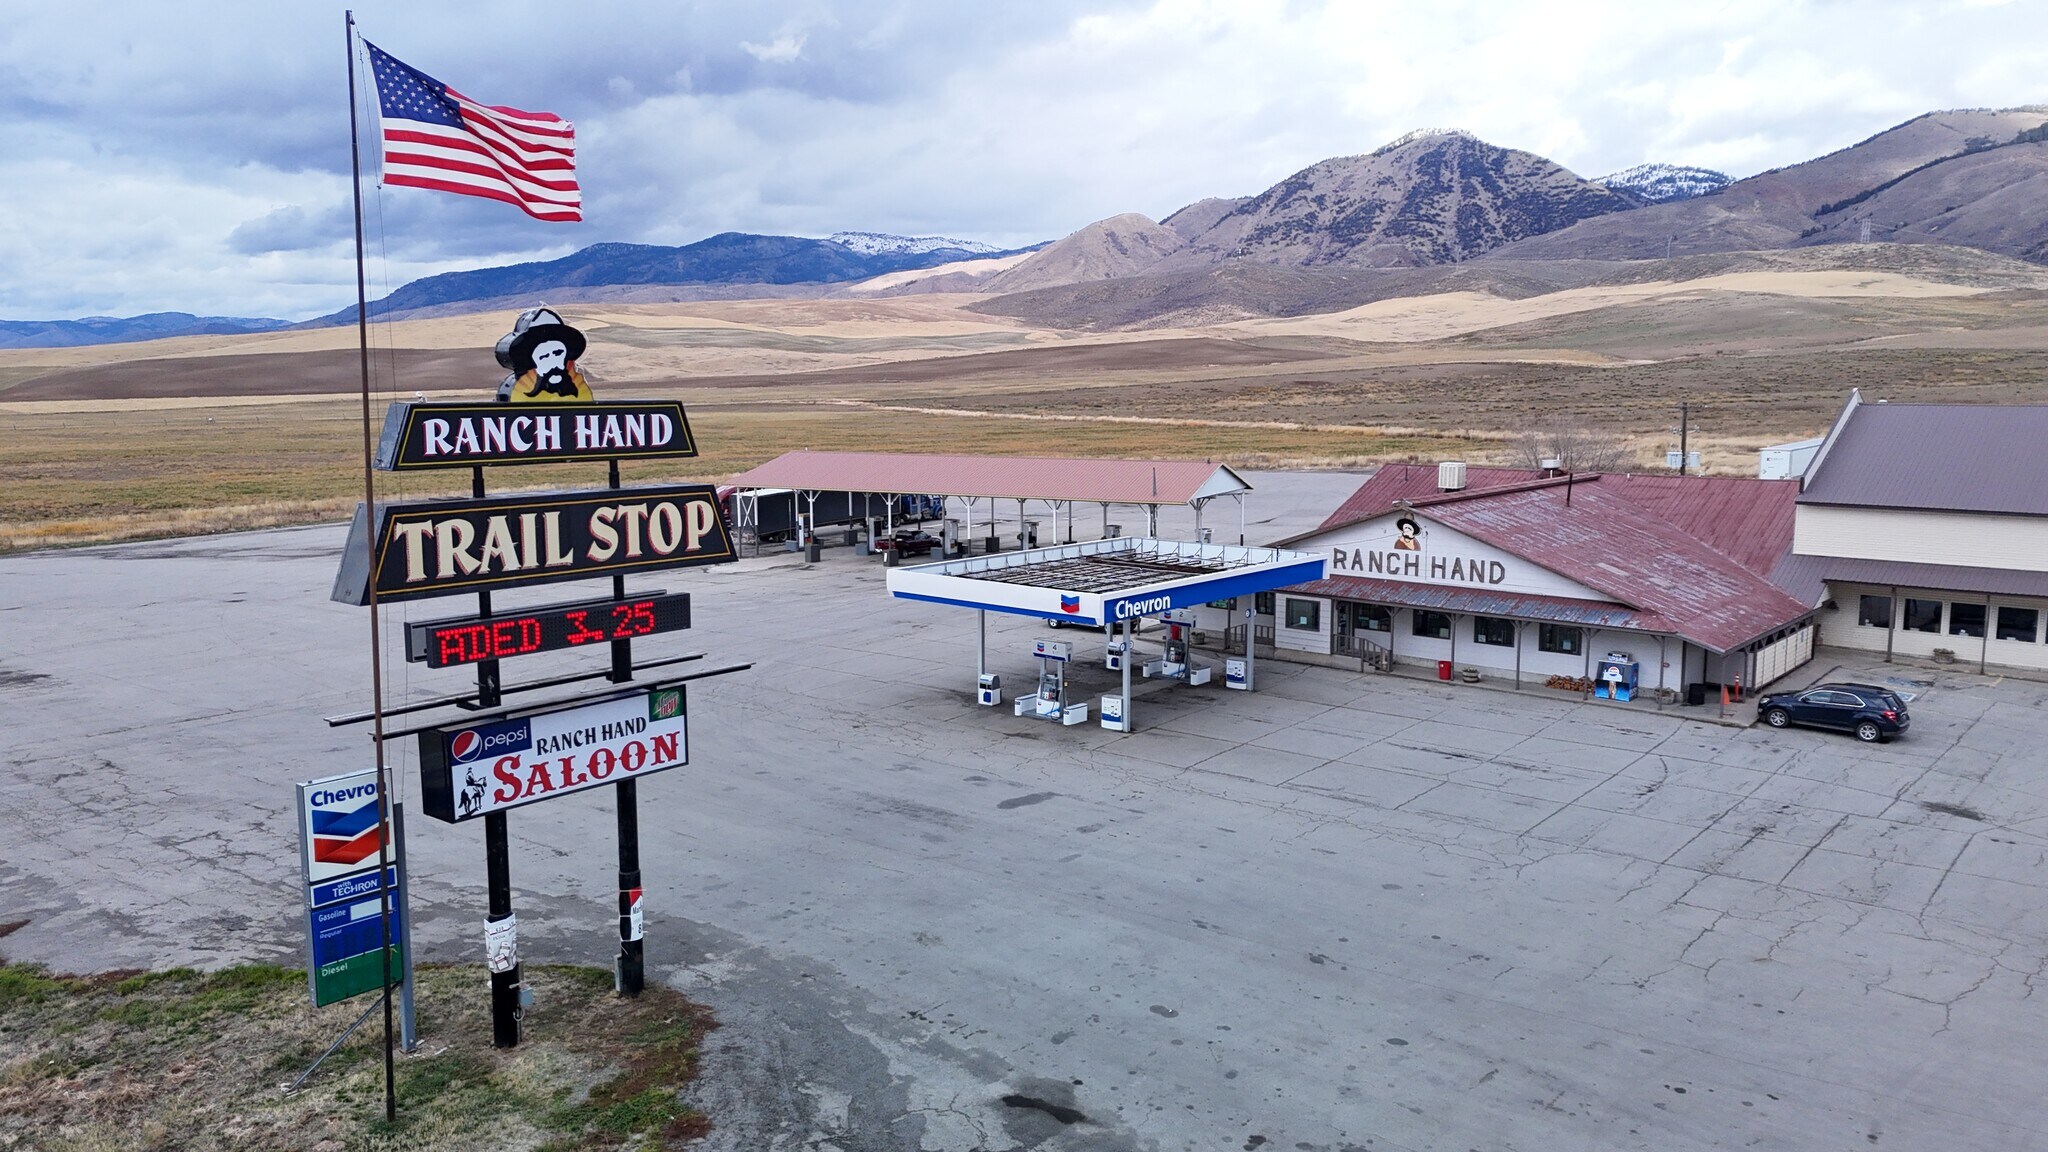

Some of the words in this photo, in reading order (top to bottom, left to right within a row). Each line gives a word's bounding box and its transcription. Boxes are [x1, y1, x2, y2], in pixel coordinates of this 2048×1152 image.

[423, 415, 561, 455] RANCH
[574, 413, 673, 448] HAND
[393, 511, 574, 583] TRAIL
[587, 500, 715, 562] STOP
[1333, 547, 1419, 576] RANCH
[1431, 556, 1505, 585] HAND
[1115, 595, 1171, 619] Chevron
[484, 726, 527, 750] pepsi
[536, 727, 597, 756] RANCH
[601, 716, 647, 742] HAND
[493, 731, 680, 804] SALOON
[332, 879, 378, 898] TECHRON
[337, 881, 351, 889] with
[318, 909, 346, 922] Gasoline
[321, 963, 348, 977] Diesel
